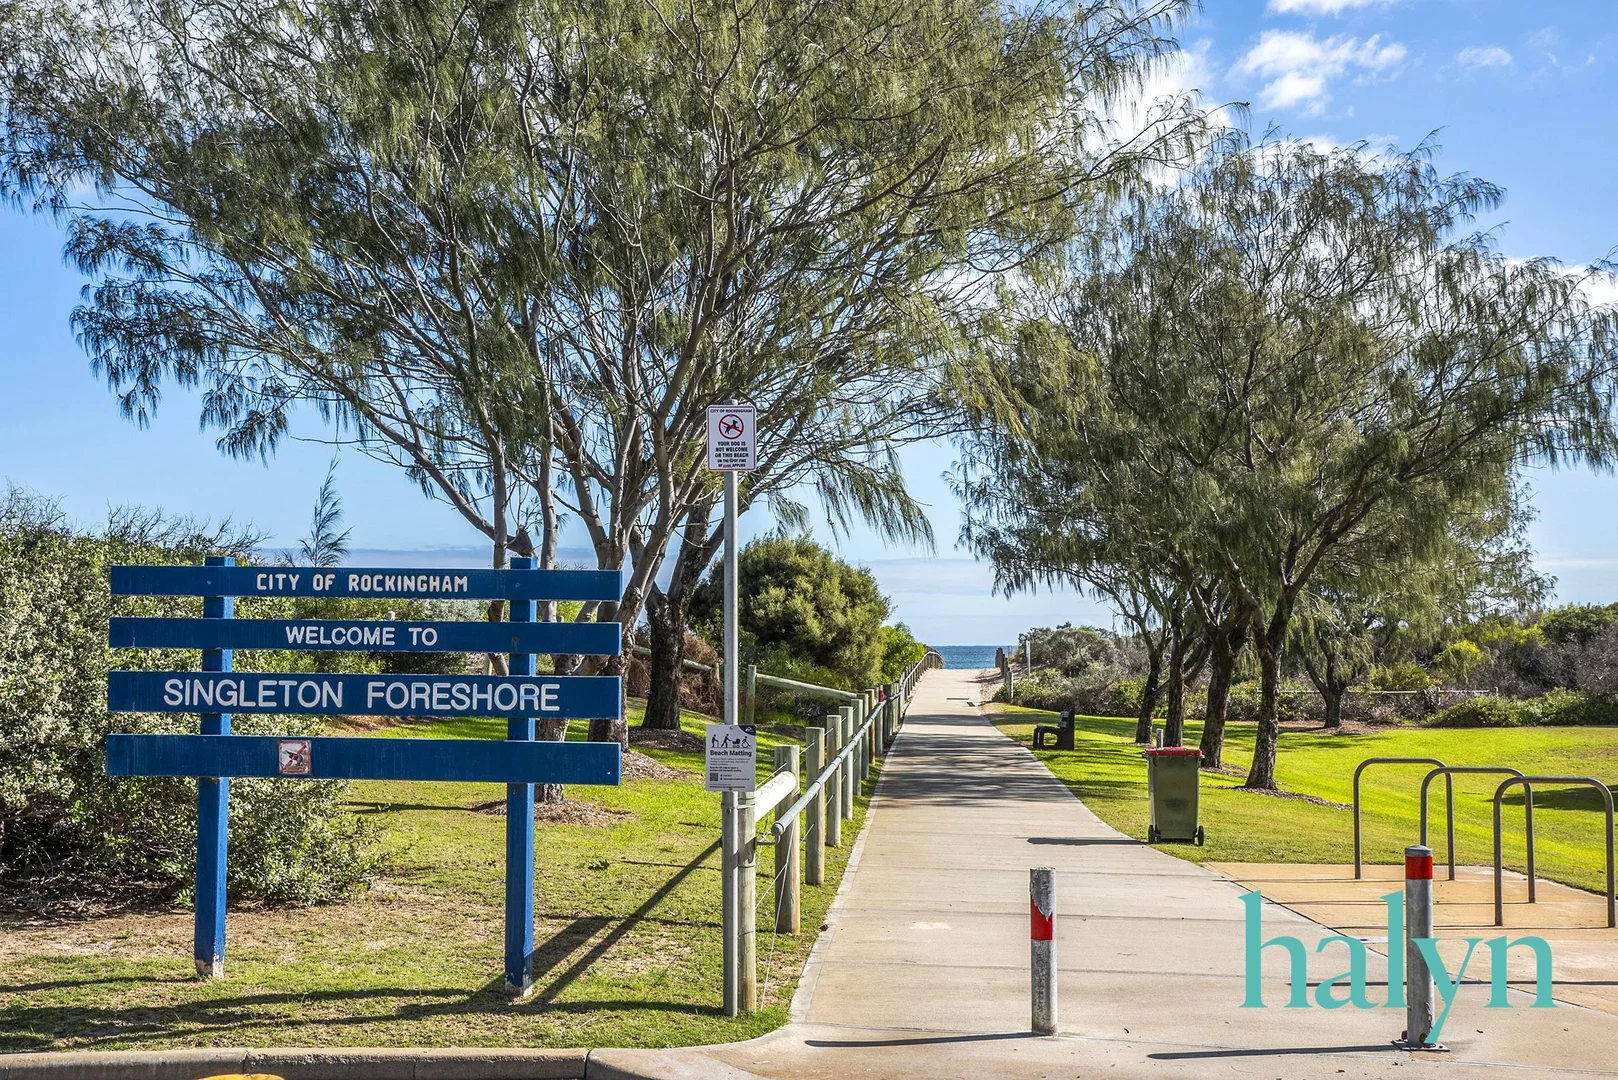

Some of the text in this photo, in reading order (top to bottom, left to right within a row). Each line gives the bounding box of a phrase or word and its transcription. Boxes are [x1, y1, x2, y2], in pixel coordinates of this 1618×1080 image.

[256, 573, 468, 593] CITY OF ROCKINGHAM
[285, 626, 438, 646] WELCOME TO
[163, 678, 560, 712] SINGLETON FORESHORE
